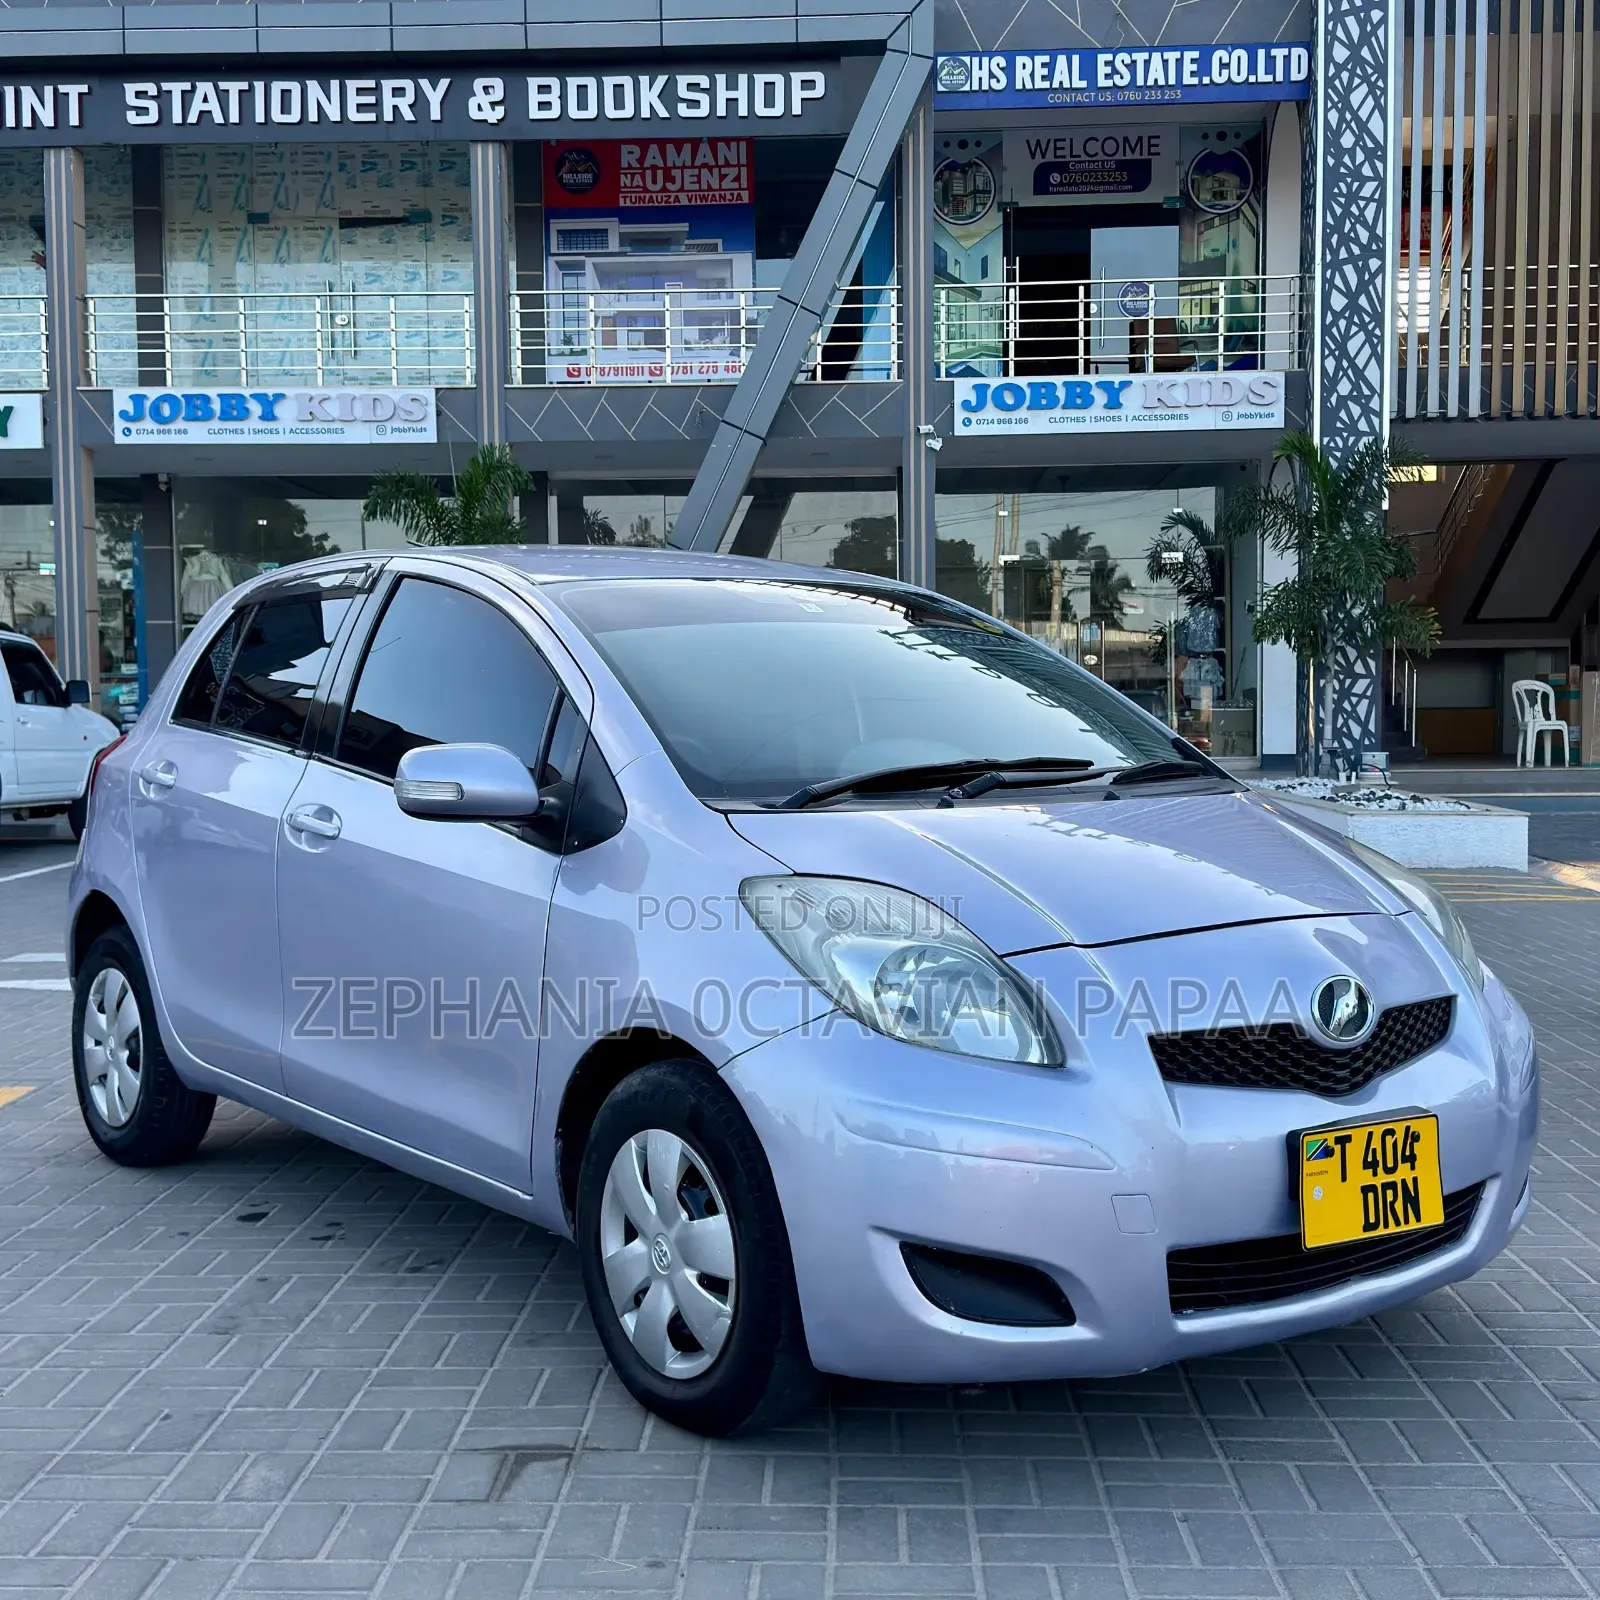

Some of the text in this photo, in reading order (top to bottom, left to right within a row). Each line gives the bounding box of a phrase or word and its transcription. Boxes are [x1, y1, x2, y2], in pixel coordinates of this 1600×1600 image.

[972, 56, 1007, 91] HS
[1015, 54, 1088, 90] REAL
[2, 72, 826, 127] INT STATIONERY & BOOKSHOP
[1048, 93, 1096, 102] CONTACT
[1118, 92, 1142, 100] 0760
[1144, 90, 1162, 100] 233
[1164, 90, 1182, 99] 253
[620, 141, 746, 168] RAMANI
[1026, 135, 1161, 160] WELCOME
[1062, 172, 1128, 183] 0760233253
[1069, 161, 1102, 170] Contact
[620, 167, 748, 191] NA UJENZI
[622, 192, 744, 205] TUNAUZA VIWANJA
[586, 364, 644, 376] 087911911
[961, 376, 1278, 412] JOBBY KIDS
[118, 393, 428, 424] JOBBY KIDS
[1334, 1125, 1418, 1182] T 404
[1361, 1176, 1421, 1232] DRN
